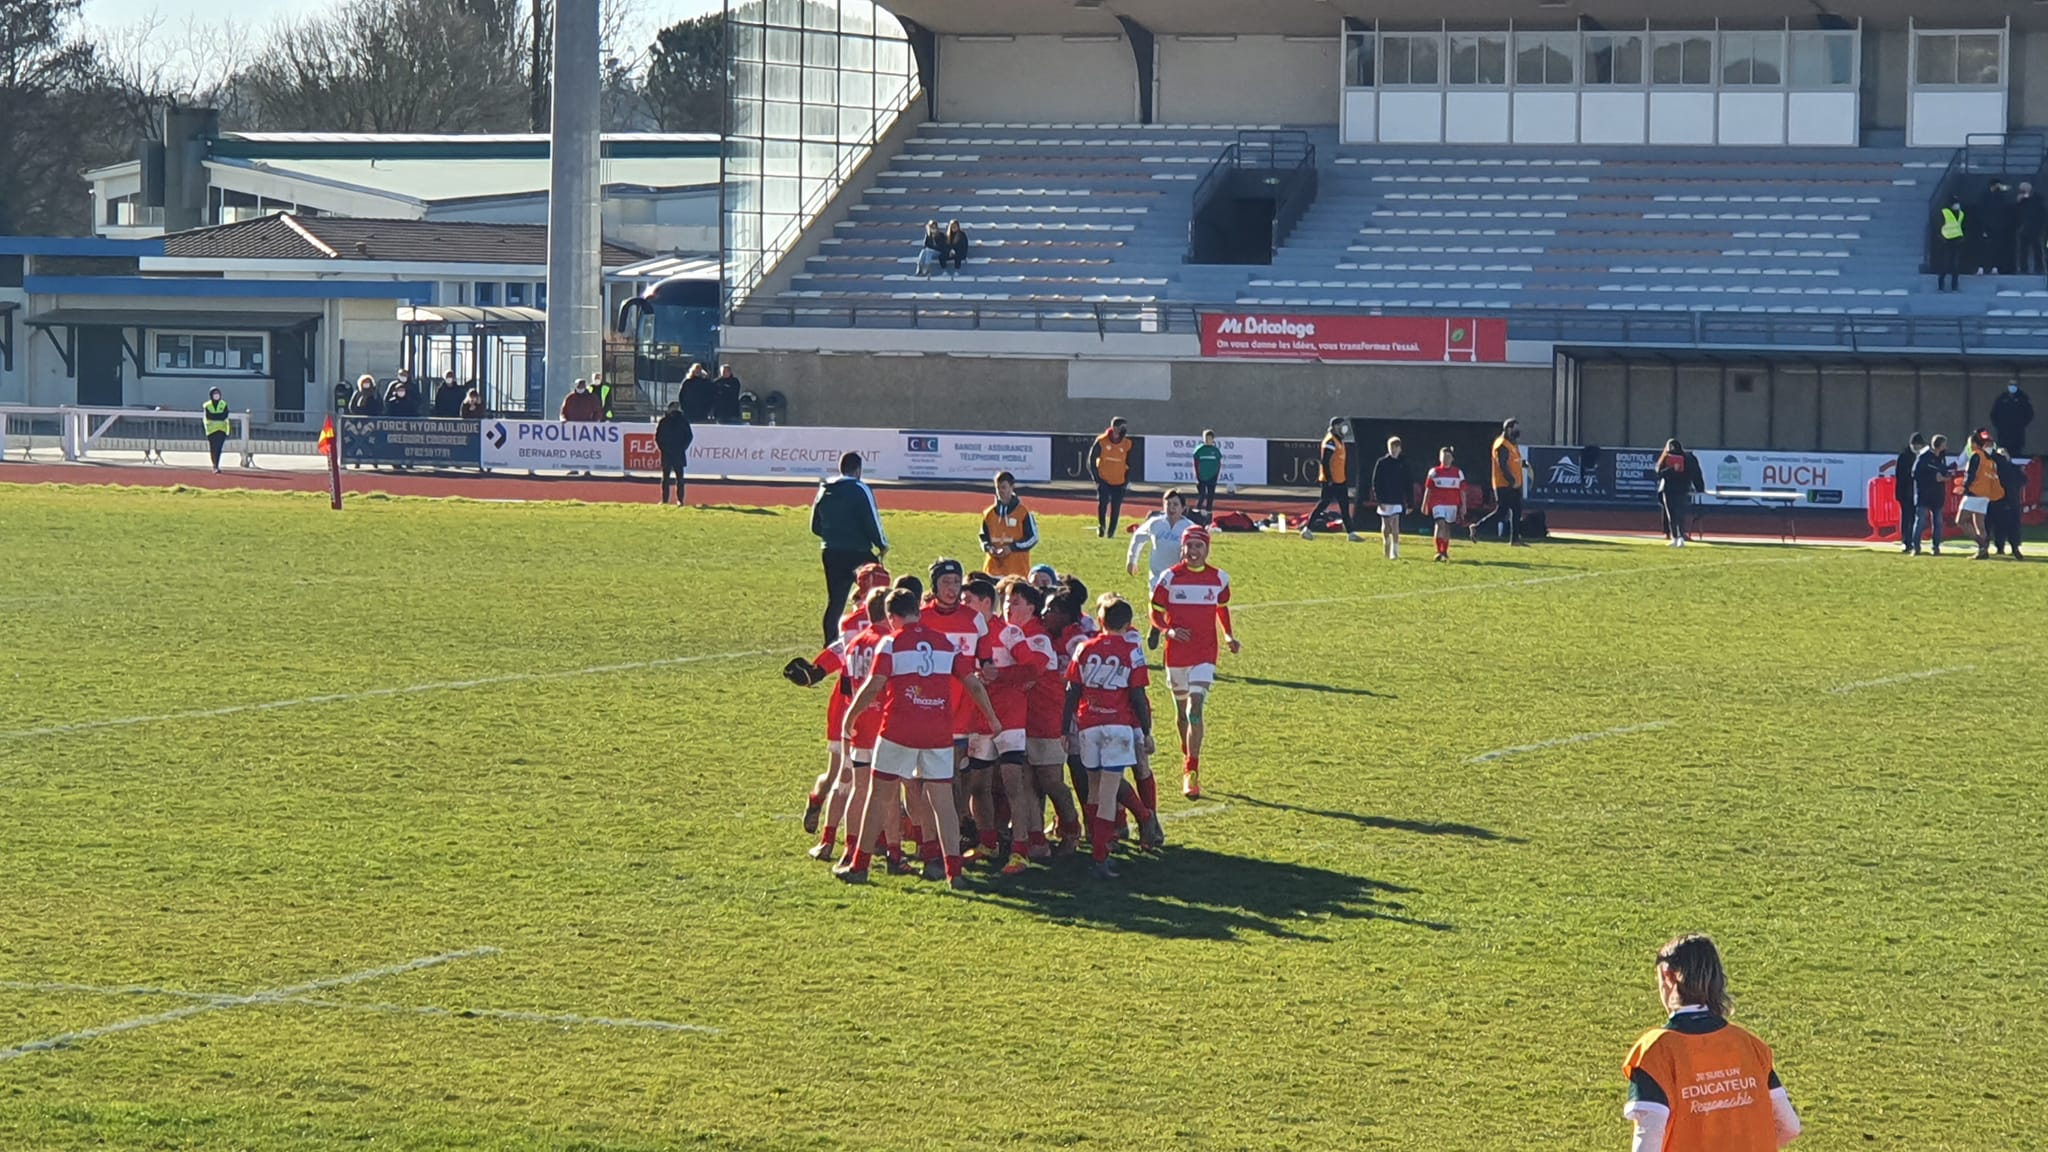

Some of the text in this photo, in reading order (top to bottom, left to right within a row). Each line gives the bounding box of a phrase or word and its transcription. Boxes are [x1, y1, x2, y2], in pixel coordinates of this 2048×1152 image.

[1217, 316, 1315, 338] Mr Bricolage
[1217, 340, 1229, 348] On
[376, 420, 480, 433] FORCE HYDRAULIQUE
[518, 424, 619, 442] PROLIANS
[519, 448, 566, 458] BERNARD
[689, 446, 880, 462] INTERIM et RECRUTEMNT
[1002, 454, 1027, 462] MOBILE
[1616, 453, 1654, 462] BOUTIQUE
[1174, 472, 1194, 480] 3211
[1763, 465, 1826, 486] AUCH
[916, 641, 934, 678] 3
[1087, 654, 1120, 690] 22
[1706, 1070, 1725, 1080] SUIS
[1725, 1067, 1740, 1077] UN
[1682, 1076, 1758, 1099] EDUCATEUR
